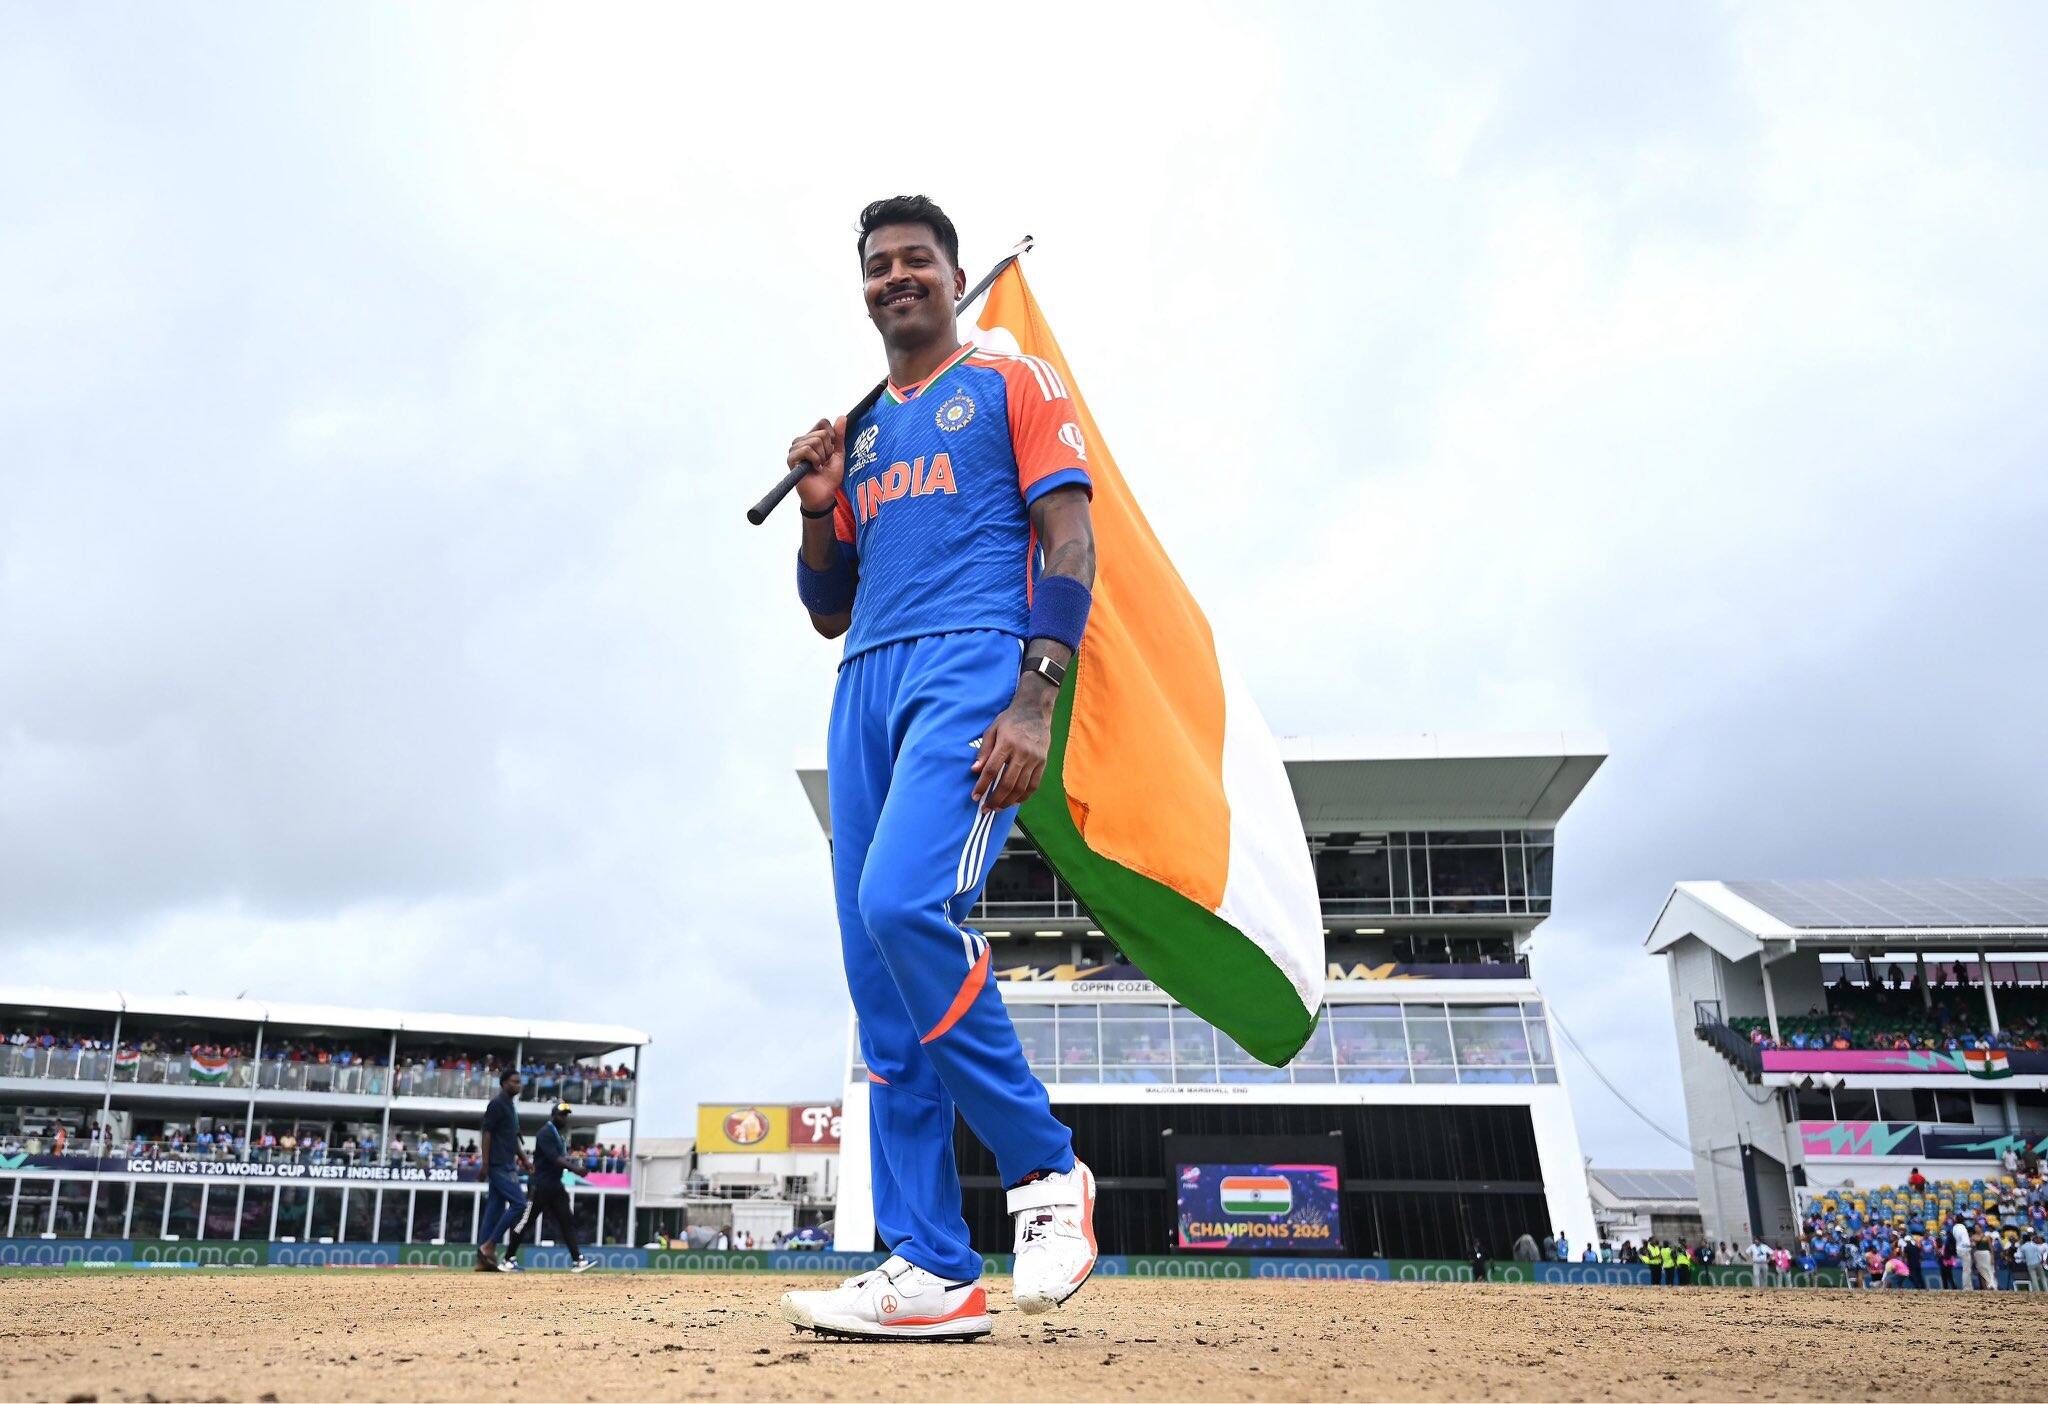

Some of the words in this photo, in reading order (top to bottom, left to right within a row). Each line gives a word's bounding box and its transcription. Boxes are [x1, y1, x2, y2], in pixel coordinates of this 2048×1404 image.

[857, 453, 958, 525] INDIA
[1071, 982, 1114, 992] COPPIN
[127, 1160, 152, 1172] ICC
[154, 1160, 198, 1174] MEN'S
[199, 1162, 224, 1175] T20
[226, 1162, 276, 1176] WORLD
[277, 1164, 305, 1177] CUP
[308, 1165, 346, 1178] WEST
[346, 1166, 390, 1180] INDIES
[391, 1168, 400, 1180] &
[401, 1168, 426, 1181] USA
[428, 1168, 458, 1181] 2024
[1189, 1221, 1289, 1238] CHAMPIONS
[1292, 1223, 1330, 1239] 2024
[1, 1244, 122, 1263] aramco
[142, 1246, 258, 1265] aramco
[277, 1248, 389, 1266] aramco
[655, 1254, 759, 1271] aramco
[776, 1255, 879, 1272] aramco
[1135, 1260, 1241, 1279] aramco
[1260, 1262, 1380, 1280] aramco
[1545, 1267, 1651, 1285] aramc
